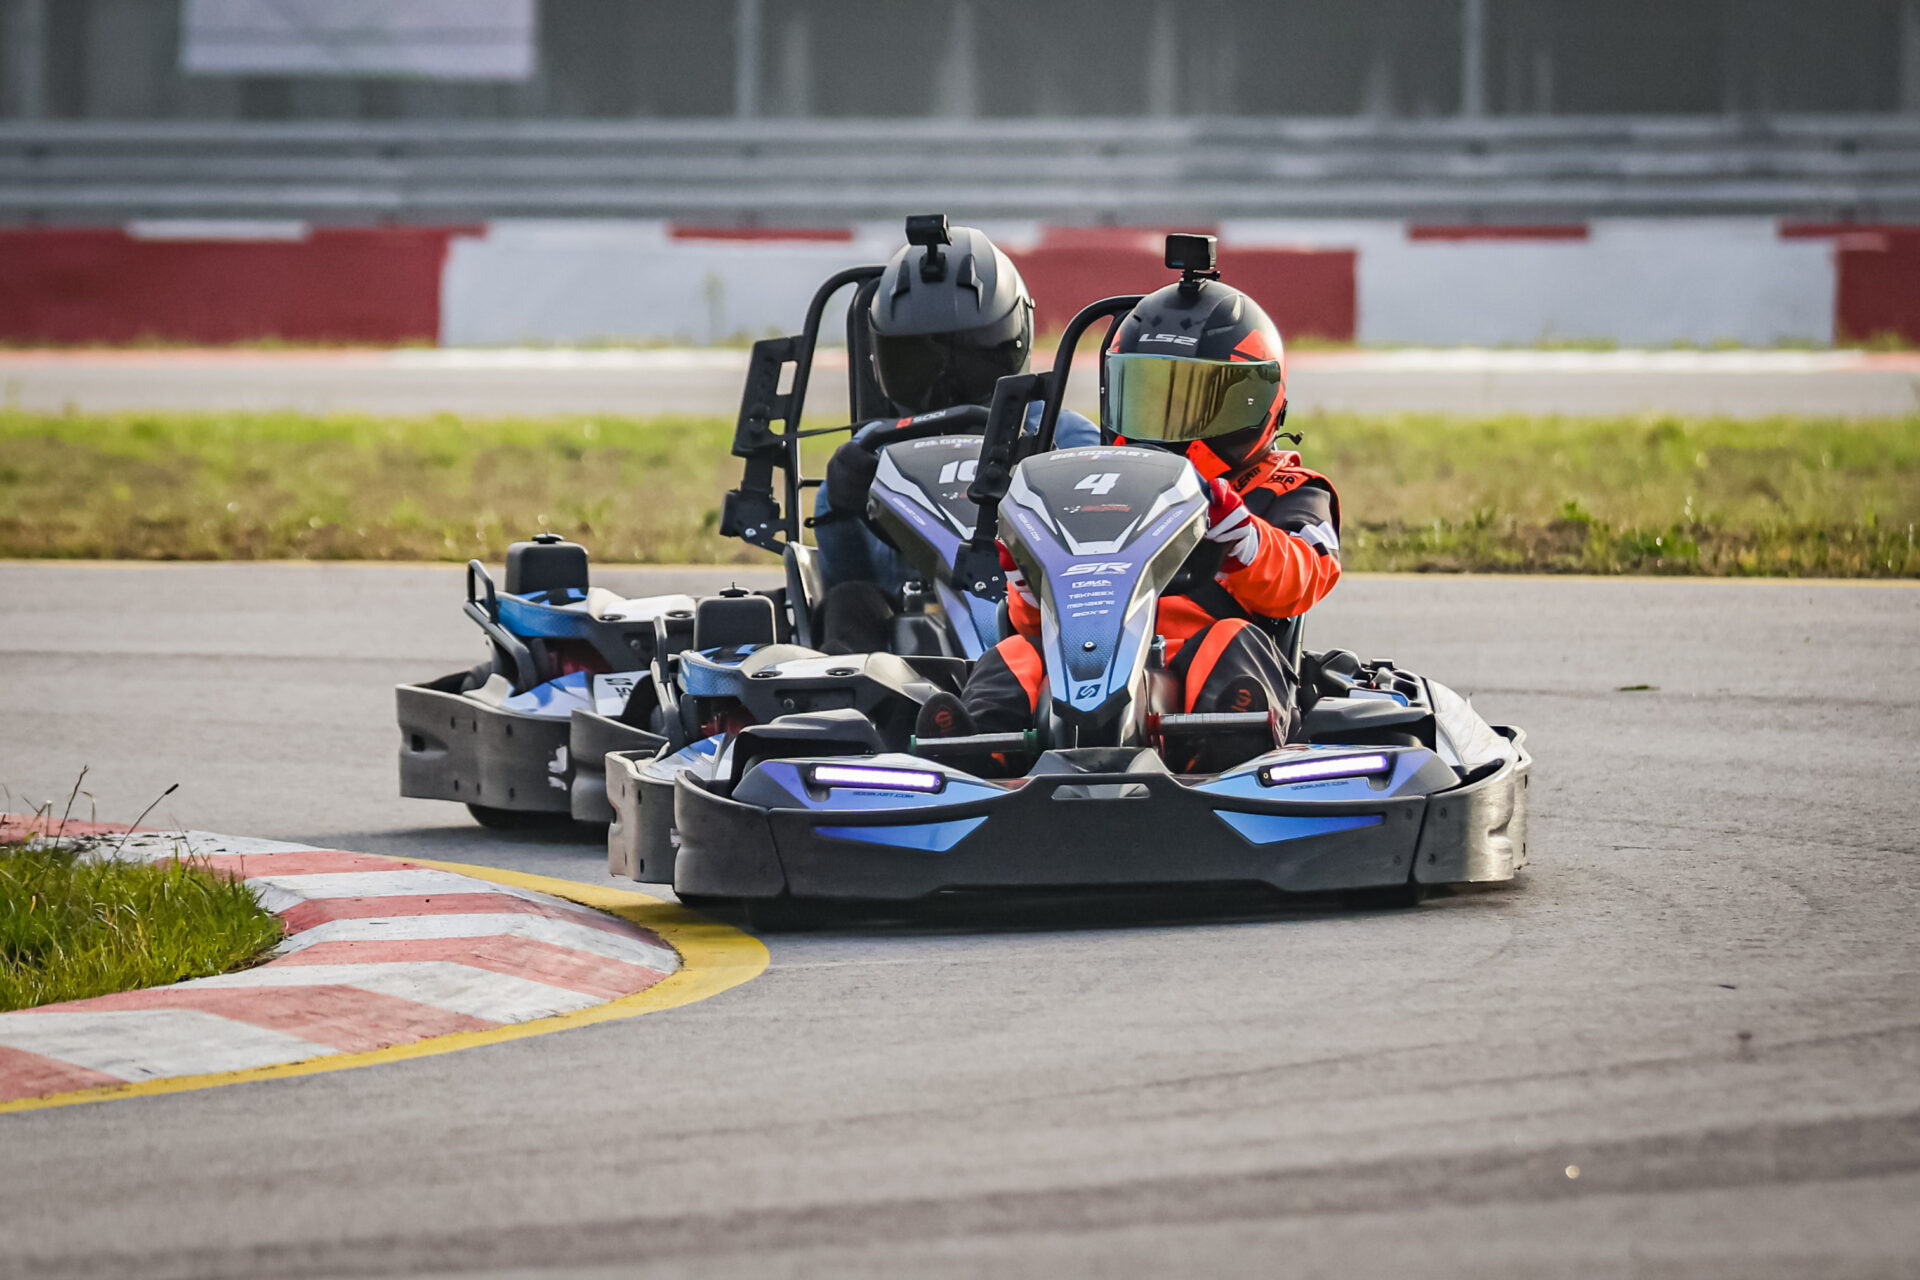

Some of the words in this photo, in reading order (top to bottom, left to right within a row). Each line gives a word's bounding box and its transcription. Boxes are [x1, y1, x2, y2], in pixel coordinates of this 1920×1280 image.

[1138, 333, 1198, 346] LS2
[1073, 472, 1122, 495] 4
[1059, 562, 1133, 577] SR
